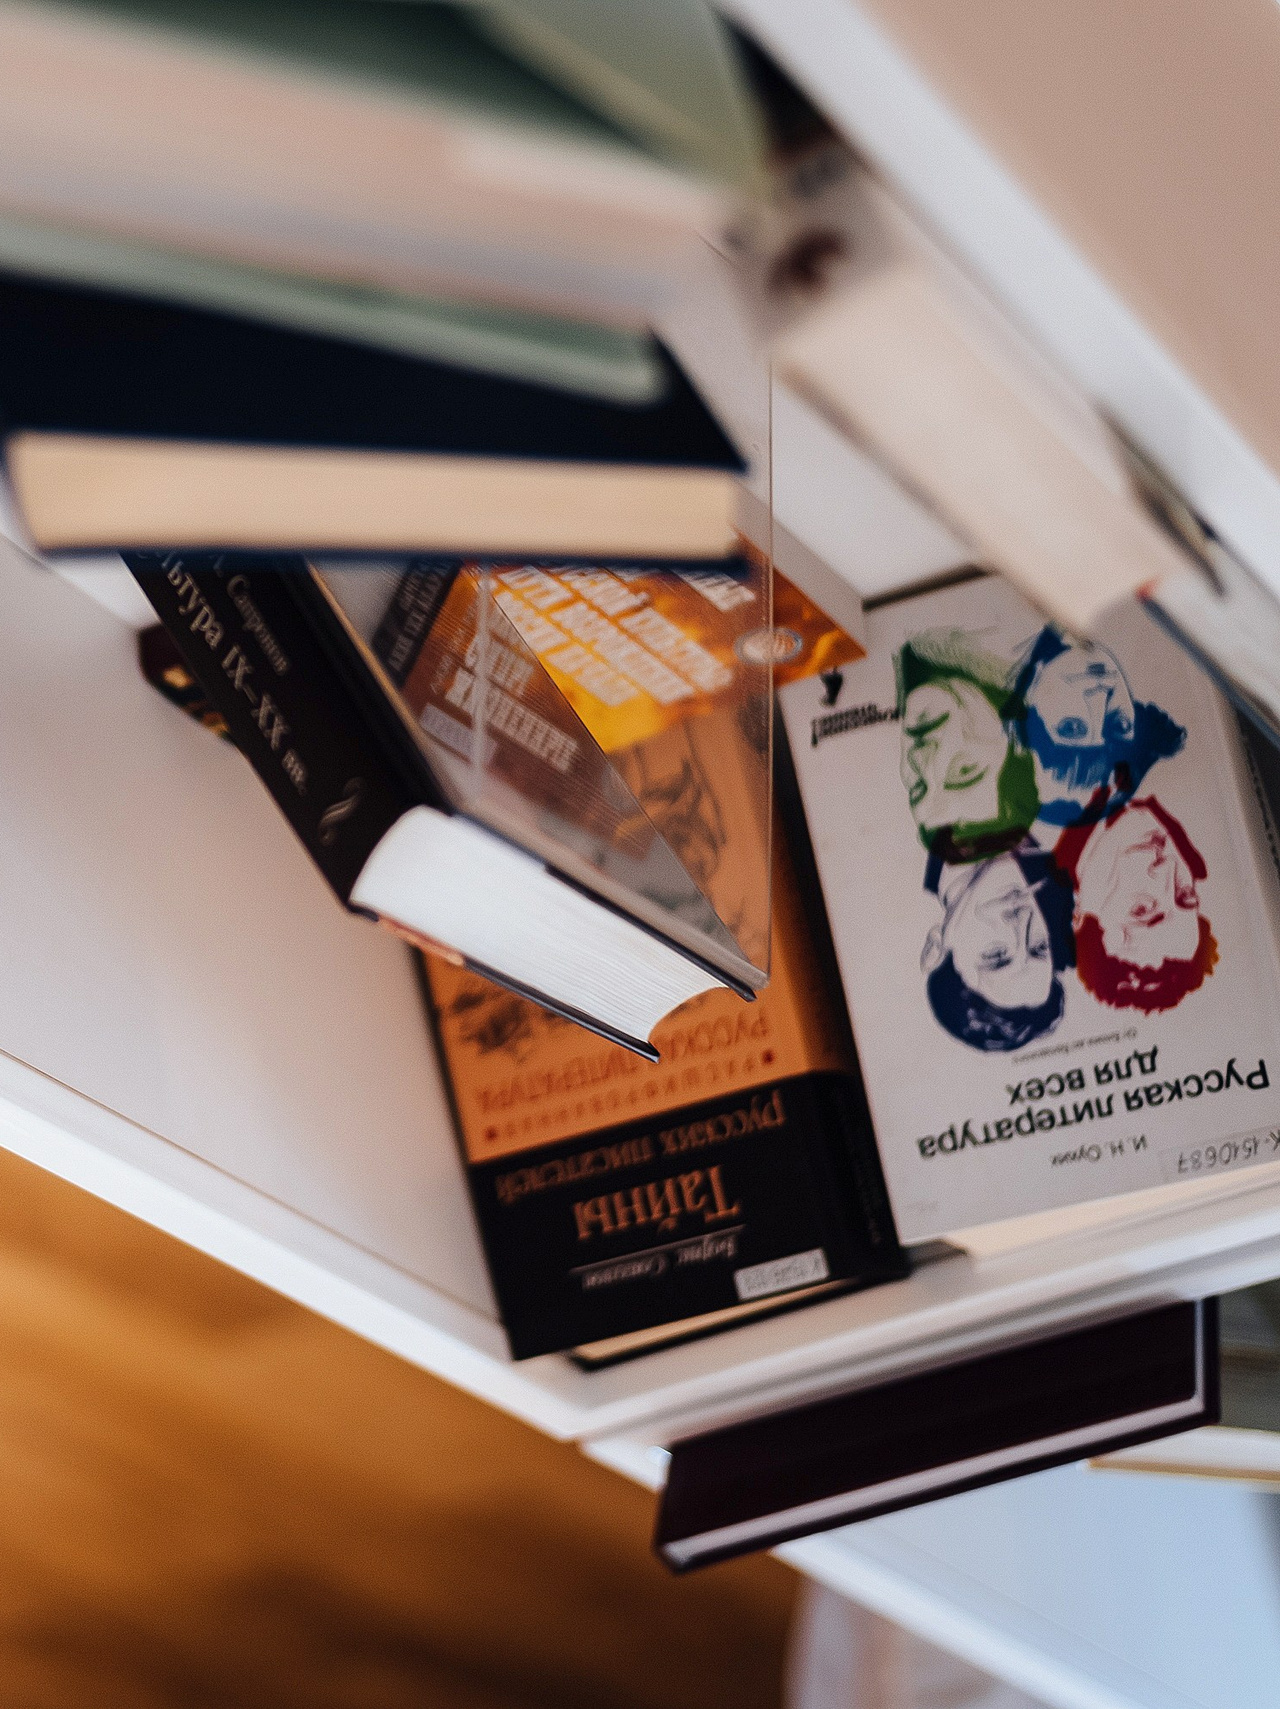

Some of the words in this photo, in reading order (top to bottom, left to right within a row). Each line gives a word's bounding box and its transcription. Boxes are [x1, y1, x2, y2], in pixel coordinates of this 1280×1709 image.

[160, 551, 224, 650] ьтура
[1004, 1067, 1086, 1107] всех
[1093, 1045, 1160, 1087] для
[1123, 1058, 1270, 1113] Русская
[658, 1088, 786, 1157] русских
[917, 1093, 1114, 1161] литература
[494, 1133, 653, 1207] писателей
[572, 1164, 740, 1243] Тайны
